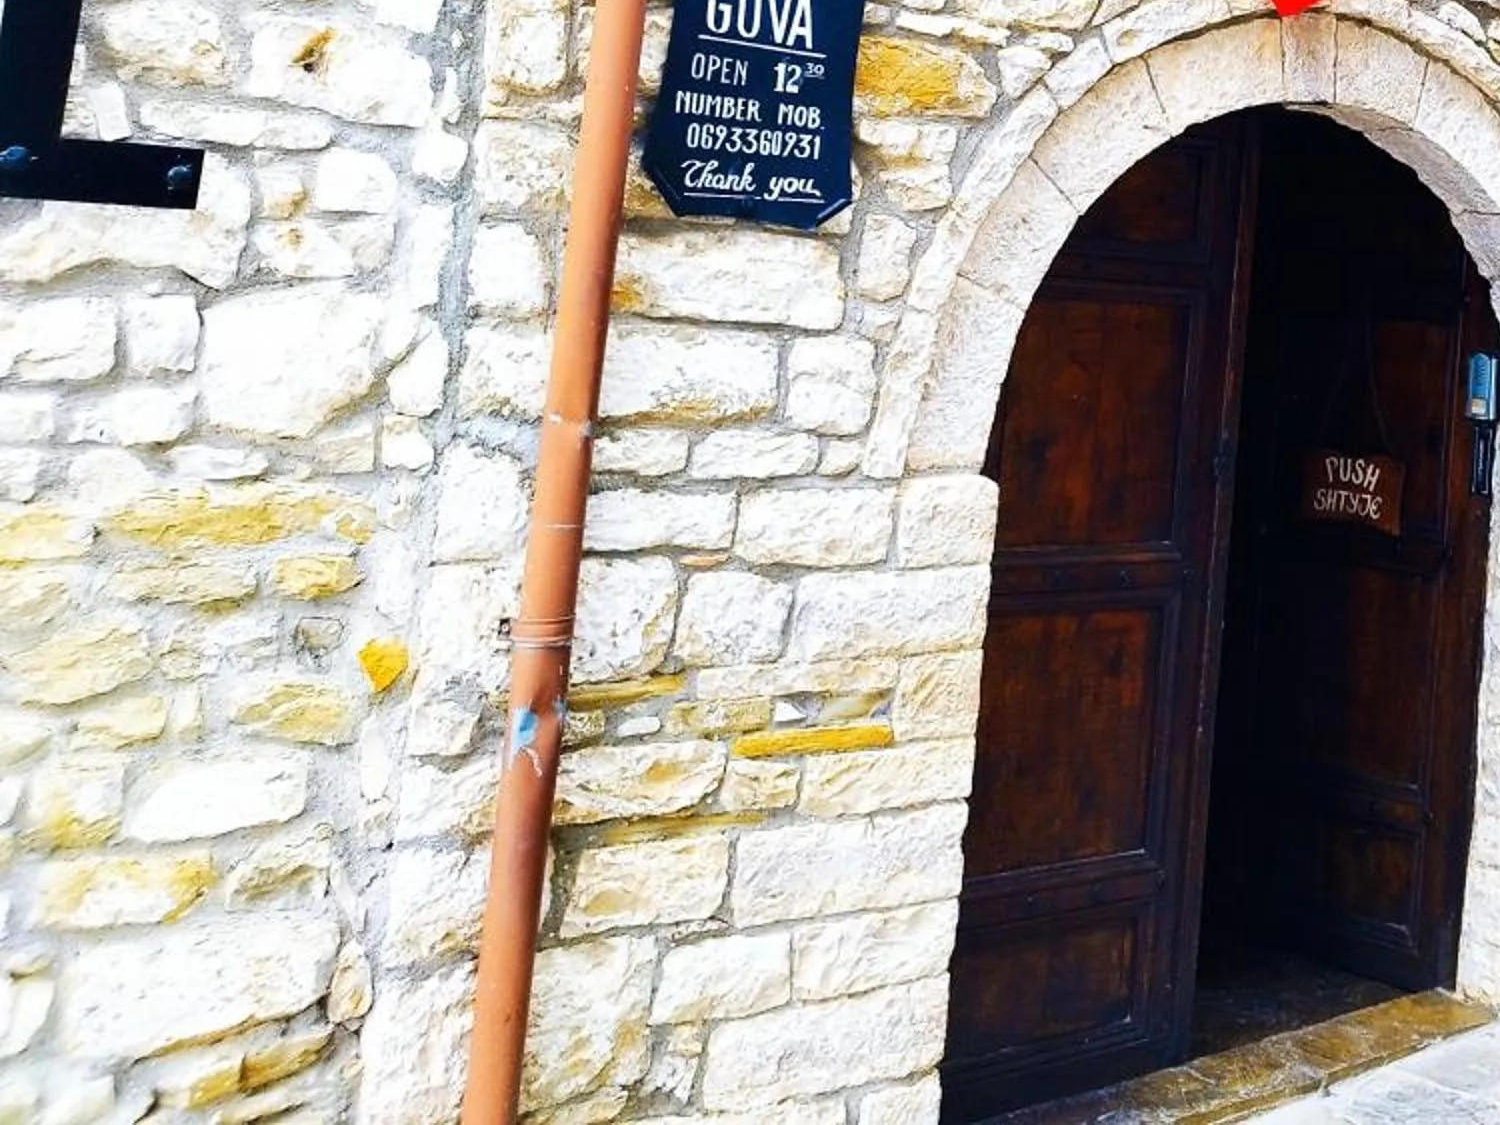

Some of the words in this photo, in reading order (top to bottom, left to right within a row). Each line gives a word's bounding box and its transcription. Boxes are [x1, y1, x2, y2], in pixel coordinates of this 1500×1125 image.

[691, 52, 749, 86] OPEN
[675, 90, 762, 122] NUMBER
[686, 122, 821, 160] 0693360931
[680, 160, 757, 192] Thank
[763, 176, 822, 201] you
[1325, 456, 1381, 492] PUSH
[1313, 488, 1383, 520] SHTYJE
